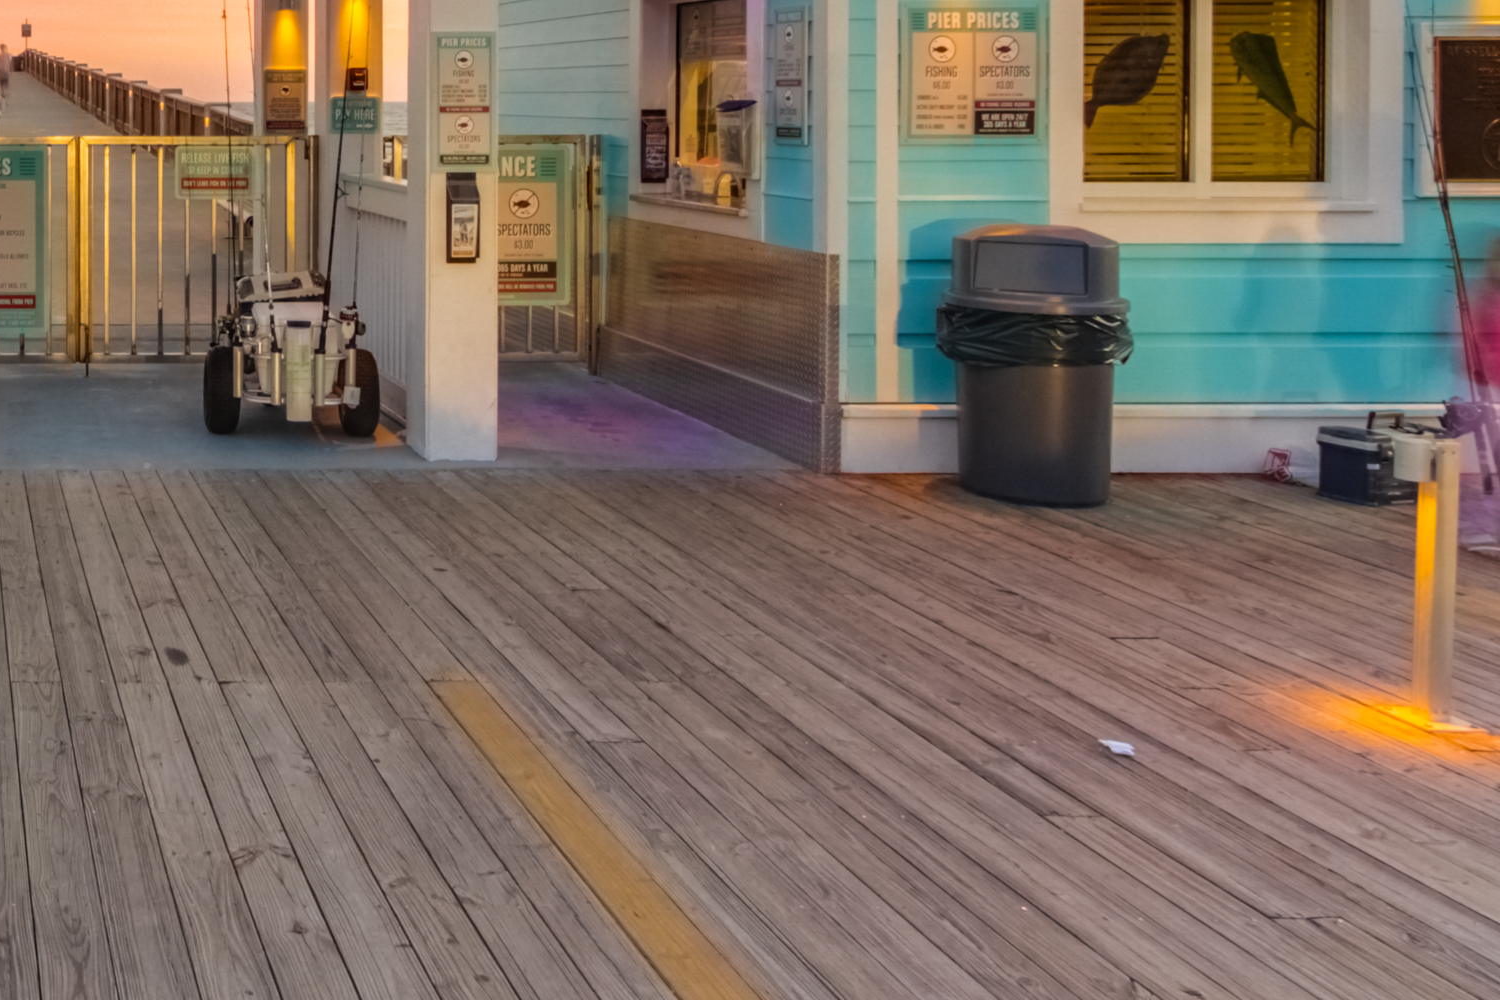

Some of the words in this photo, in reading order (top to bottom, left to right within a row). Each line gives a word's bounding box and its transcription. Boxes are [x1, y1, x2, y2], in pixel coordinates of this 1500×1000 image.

[928, 12, 961, 29] PIER
[966, 12, 1019, 29] PRICES
[441, 38, 458, 47] PIER
[460, 38, 486, 47] PRICES
[925, 66, 958, 77] FISHING
[979, 66, 1030, 77] SPECTATORS
[996, 81, 1014, 90] $3.00
[354, 109, 375, 120] HERE
[447, 135, 481, 143] SPECTATORS
[181, 153, 211, 163] RELEASE
[214, 153, 229, 163] LIVE
[232, 153, 248, 163] FISH
[187, 166, 195, 175] OR
[197, 166, 211, 175] KEEP
[213, 166, 219, 175] IN
[221, 166, 244, 175] COLER
[498, 223, 551, 236] SPECTATORS
[514, 240, 534, 249] $3.00
[510, 264, 526, 272] DAYS
[527, 264, 531, 272] A
[533, 264, 548, 272] YEAR
